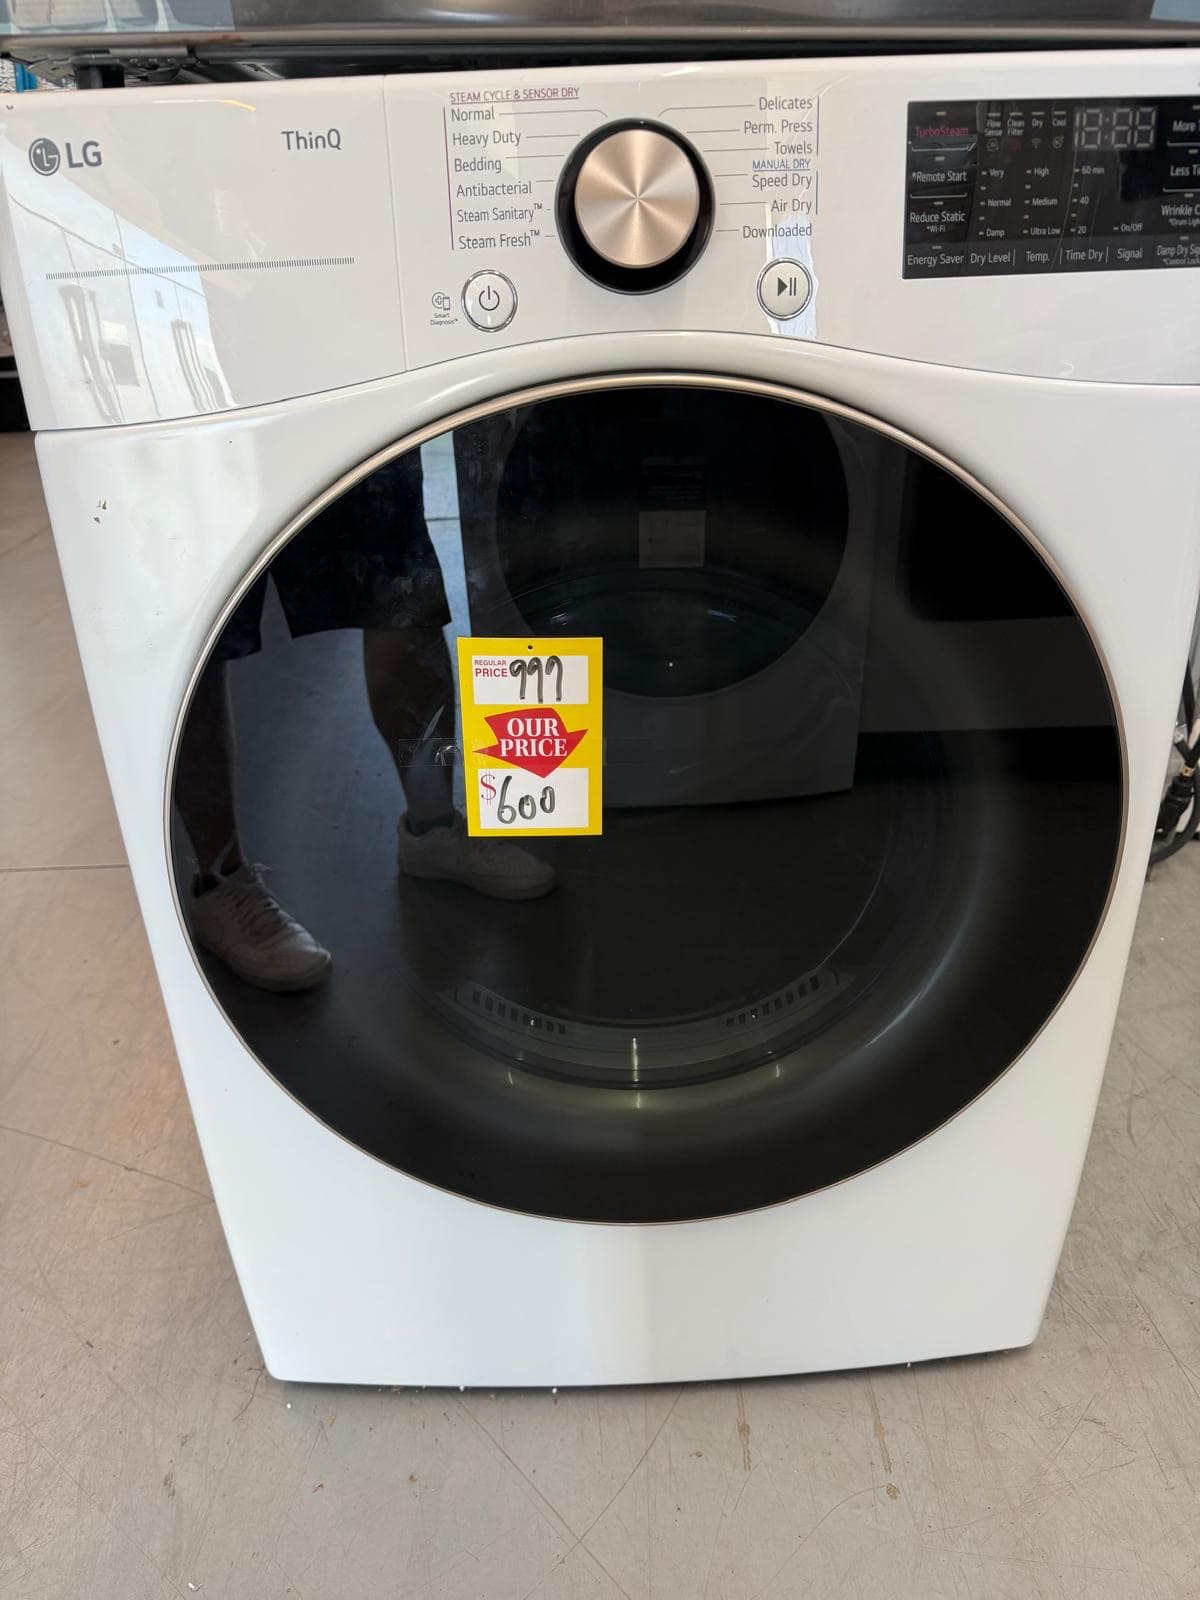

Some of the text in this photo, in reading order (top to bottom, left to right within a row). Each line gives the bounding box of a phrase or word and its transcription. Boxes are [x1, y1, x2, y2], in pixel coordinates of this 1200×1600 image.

[450, 87, 580, 103] STEAM CYCLE & SENSOR DRY
[759, 96, 813, 110] Delicates
[451, 106, 495, 122] Normal
[744, 119, 813, 134] Perm. Press
[1007, 118, 1025, 127] Clean
[1031, 118, 1043, 128] Dry
[1052, 118, 1067, 127] Cool
[1172, 120, 1197, 132] More
[915, 126, 968, 137] TurboSteam
[1007, 128, 1024, 136] Filter
[280, 128, 341, 150] ThinQ
[452, 130, 521, 148] Heavy Duty
[65, 140, 102, 168] LG
[774, 140, 813, 155] Towels
[454, 156, 502, 173] Bedding
[752, 158, 811, 170] MANUAL DRY
[1081, 166, 1091, 175] 60
[1170, 165, 1190, 176] Less
[947, 170, 967, 182] Start
[989, 168, 1005, 178] Very
[1034, 167, 1050, 178] High
[752, 172, 812, 191] Speed Dry
[456, 180, 532, 197] Antibacterial
[771, 198, 812, 215] Air Dry
[987, 198, 1012, 207] Normal
[1032, 197, 1058, 206] Medium
[1080, 196, 1090, 205] 40
[457, 209, 490, 222] Steam
[1161, 204, 1193, 216] Wrinkle
[910, 211, 966, 223] Reduce Static
[743, 223, 812, 239] Downloaded
[986, 228, 1005, 239] Damp
[1030, 227, 1061, 236] Ultra Low
[1077, 226, 1087, 235] 20
[1120, 222, 1143, 232] On/Off
[459, 235, 496, 249] Steam
[1065, 249, 1104, 263] Time Dry
[1117, 247, 1143, 262] Signal
[1157, 245, 1175, 257] Damp
[1177, 244, 1189, 257] Dry
[907, 253, 965, 268] Energy Saver
[970, 251, 1011, 266] Dry Level
[1026, 251, 1050, 264] Temp.
[475, 668, 508, 677] PRICE
[507, 717, 559, 737] OUR
[500, 738, 568, 757] PRICE
